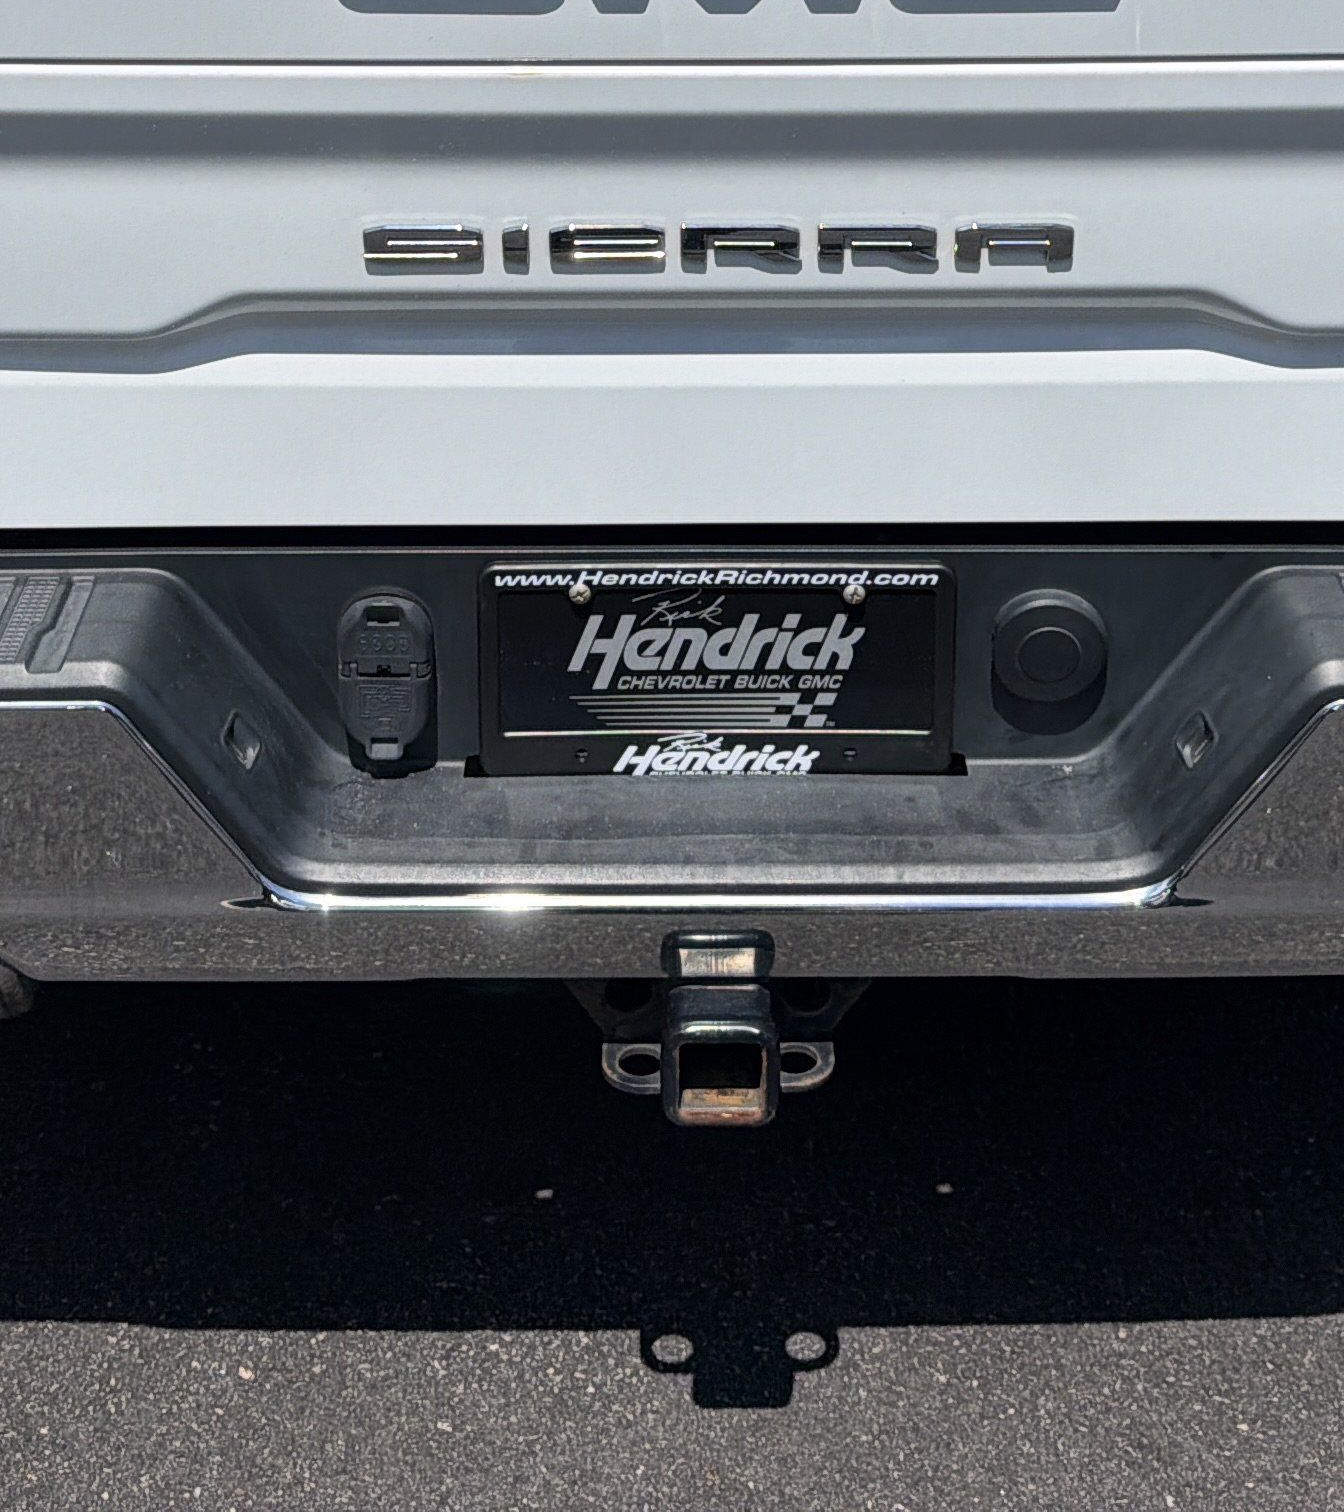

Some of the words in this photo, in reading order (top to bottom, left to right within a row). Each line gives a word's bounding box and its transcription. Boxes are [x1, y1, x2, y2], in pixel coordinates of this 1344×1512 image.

[363, 222, 1075, 275] SIERRA
[494, 569, 939, 587] www.HendrickRichmond.com
[567, 613, 866, 689] Hendrick
[617, 674, 731, 690] CHEVROLET
[734, 674, 794, 689] BUICK
[797, 674, 843, 689] GMC
[612, 744, 821, 776] Hendrick
